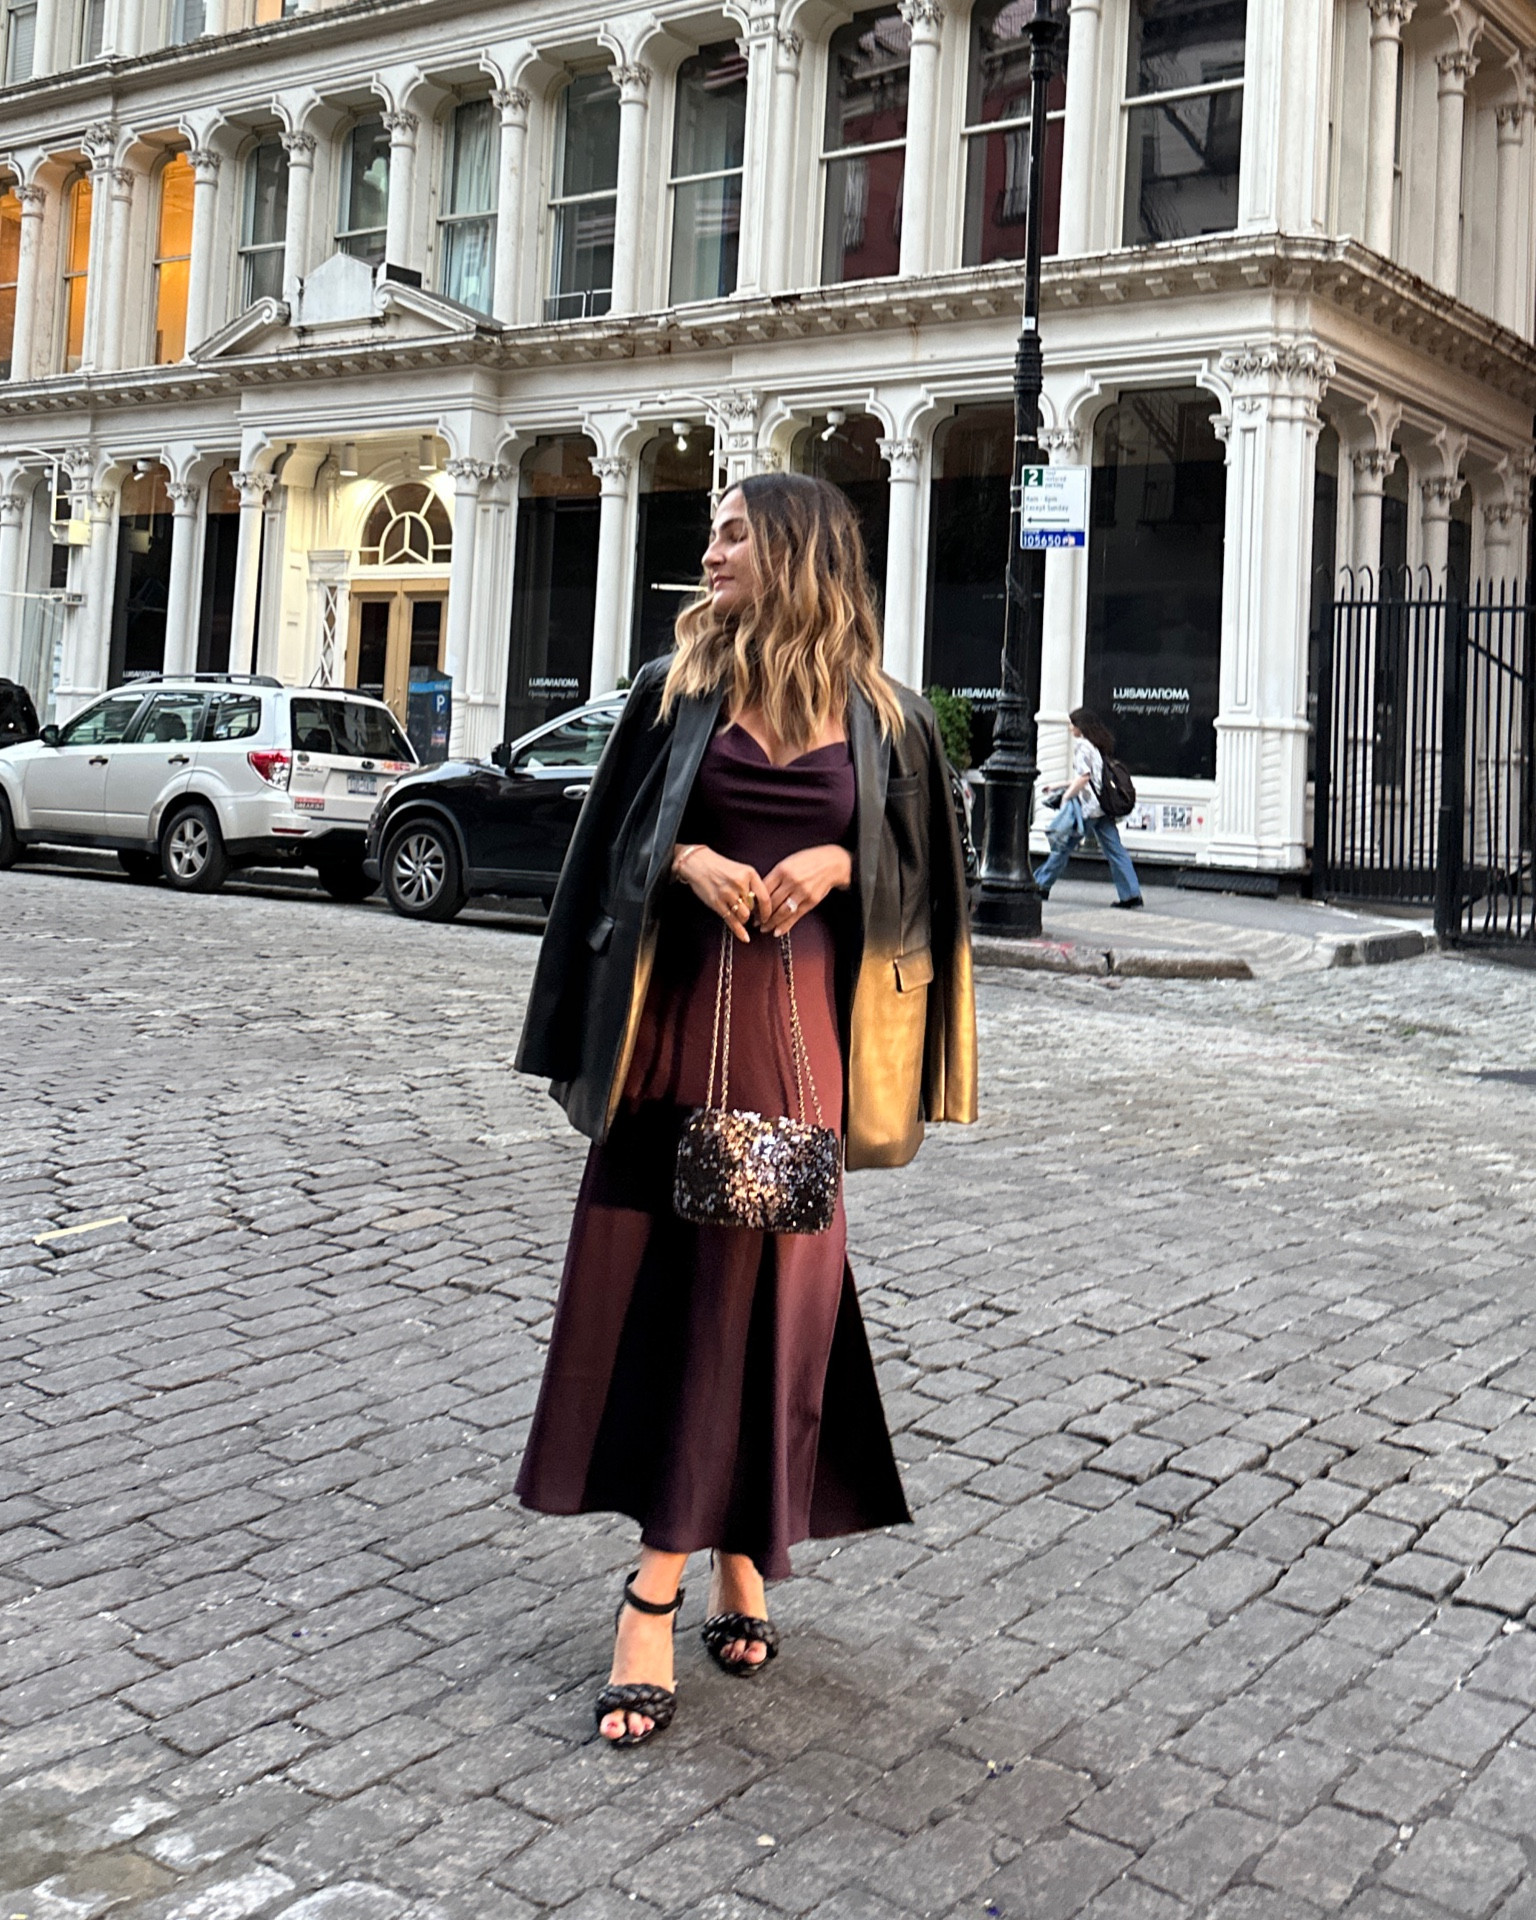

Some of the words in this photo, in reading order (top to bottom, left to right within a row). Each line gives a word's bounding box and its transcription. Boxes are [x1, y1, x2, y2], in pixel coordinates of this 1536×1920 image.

[1028, 469, 1039, 486] 2
[1047, 505, 1069, 513] Sunday
[1113, 687, 1190, 700] LUISAVIAROMA
[436, 694, 446, 712] P
